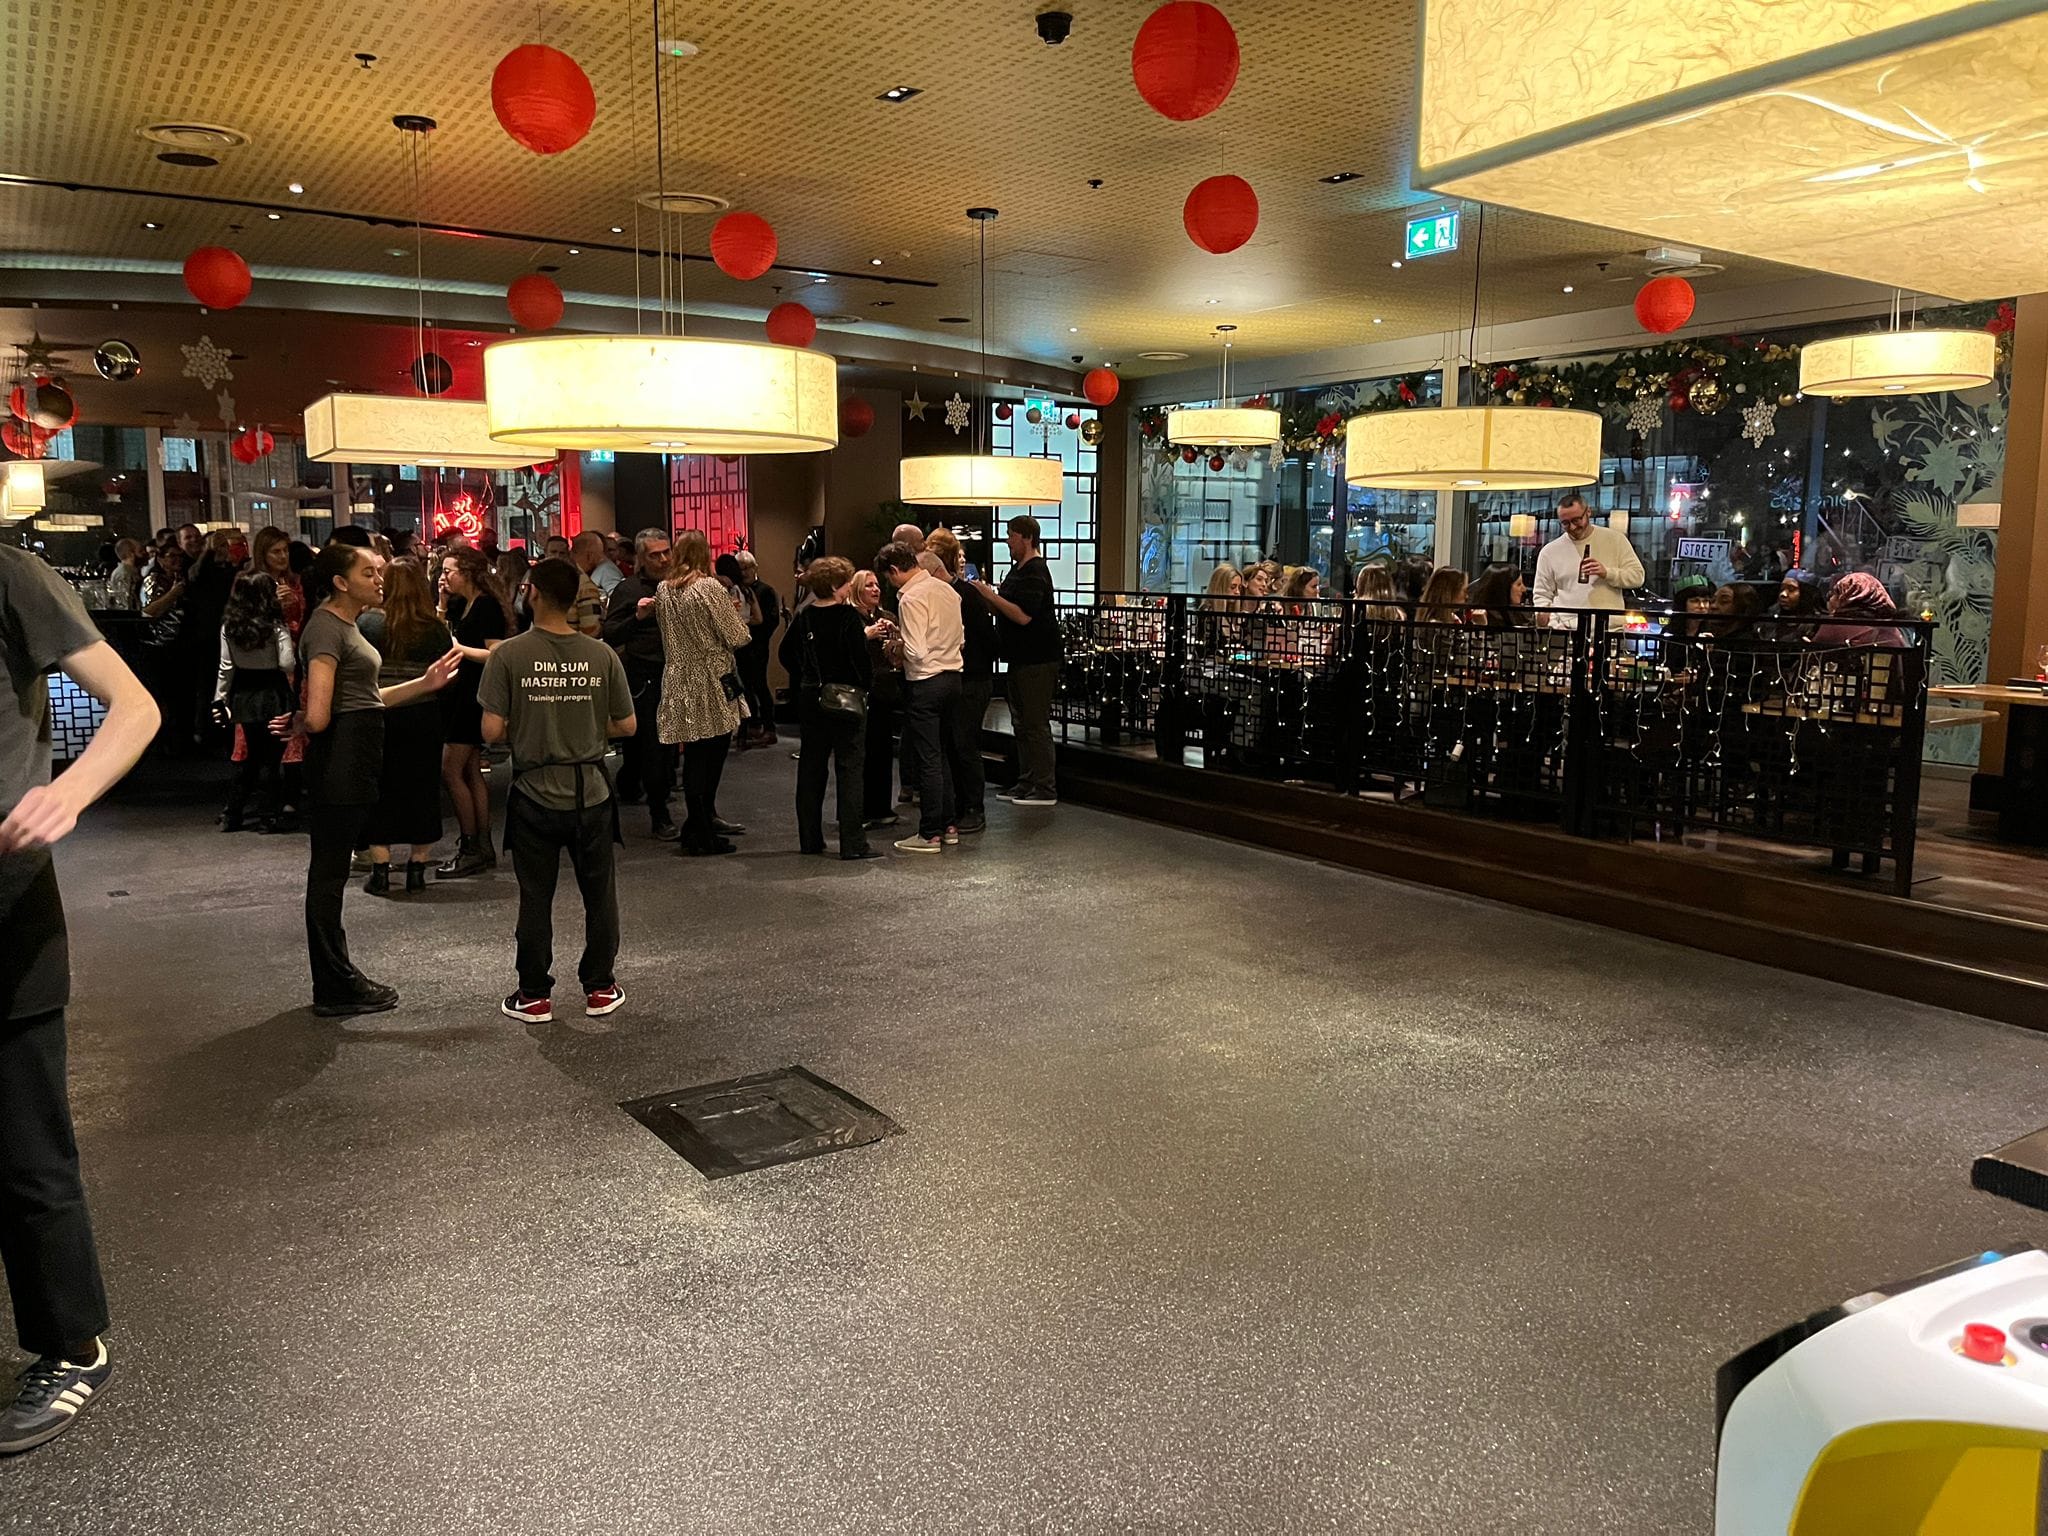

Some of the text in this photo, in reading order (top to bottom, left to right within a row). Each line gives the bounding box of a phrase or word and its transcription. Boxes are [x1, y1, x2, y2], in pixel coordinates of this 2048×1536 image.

[1684, 543, 1723, 558] STREET
[534, 661, 589, 672] DIM SUM
[521, 677, 602, 688] MASTER TO BE
[528, 694, 555, 702] Training
